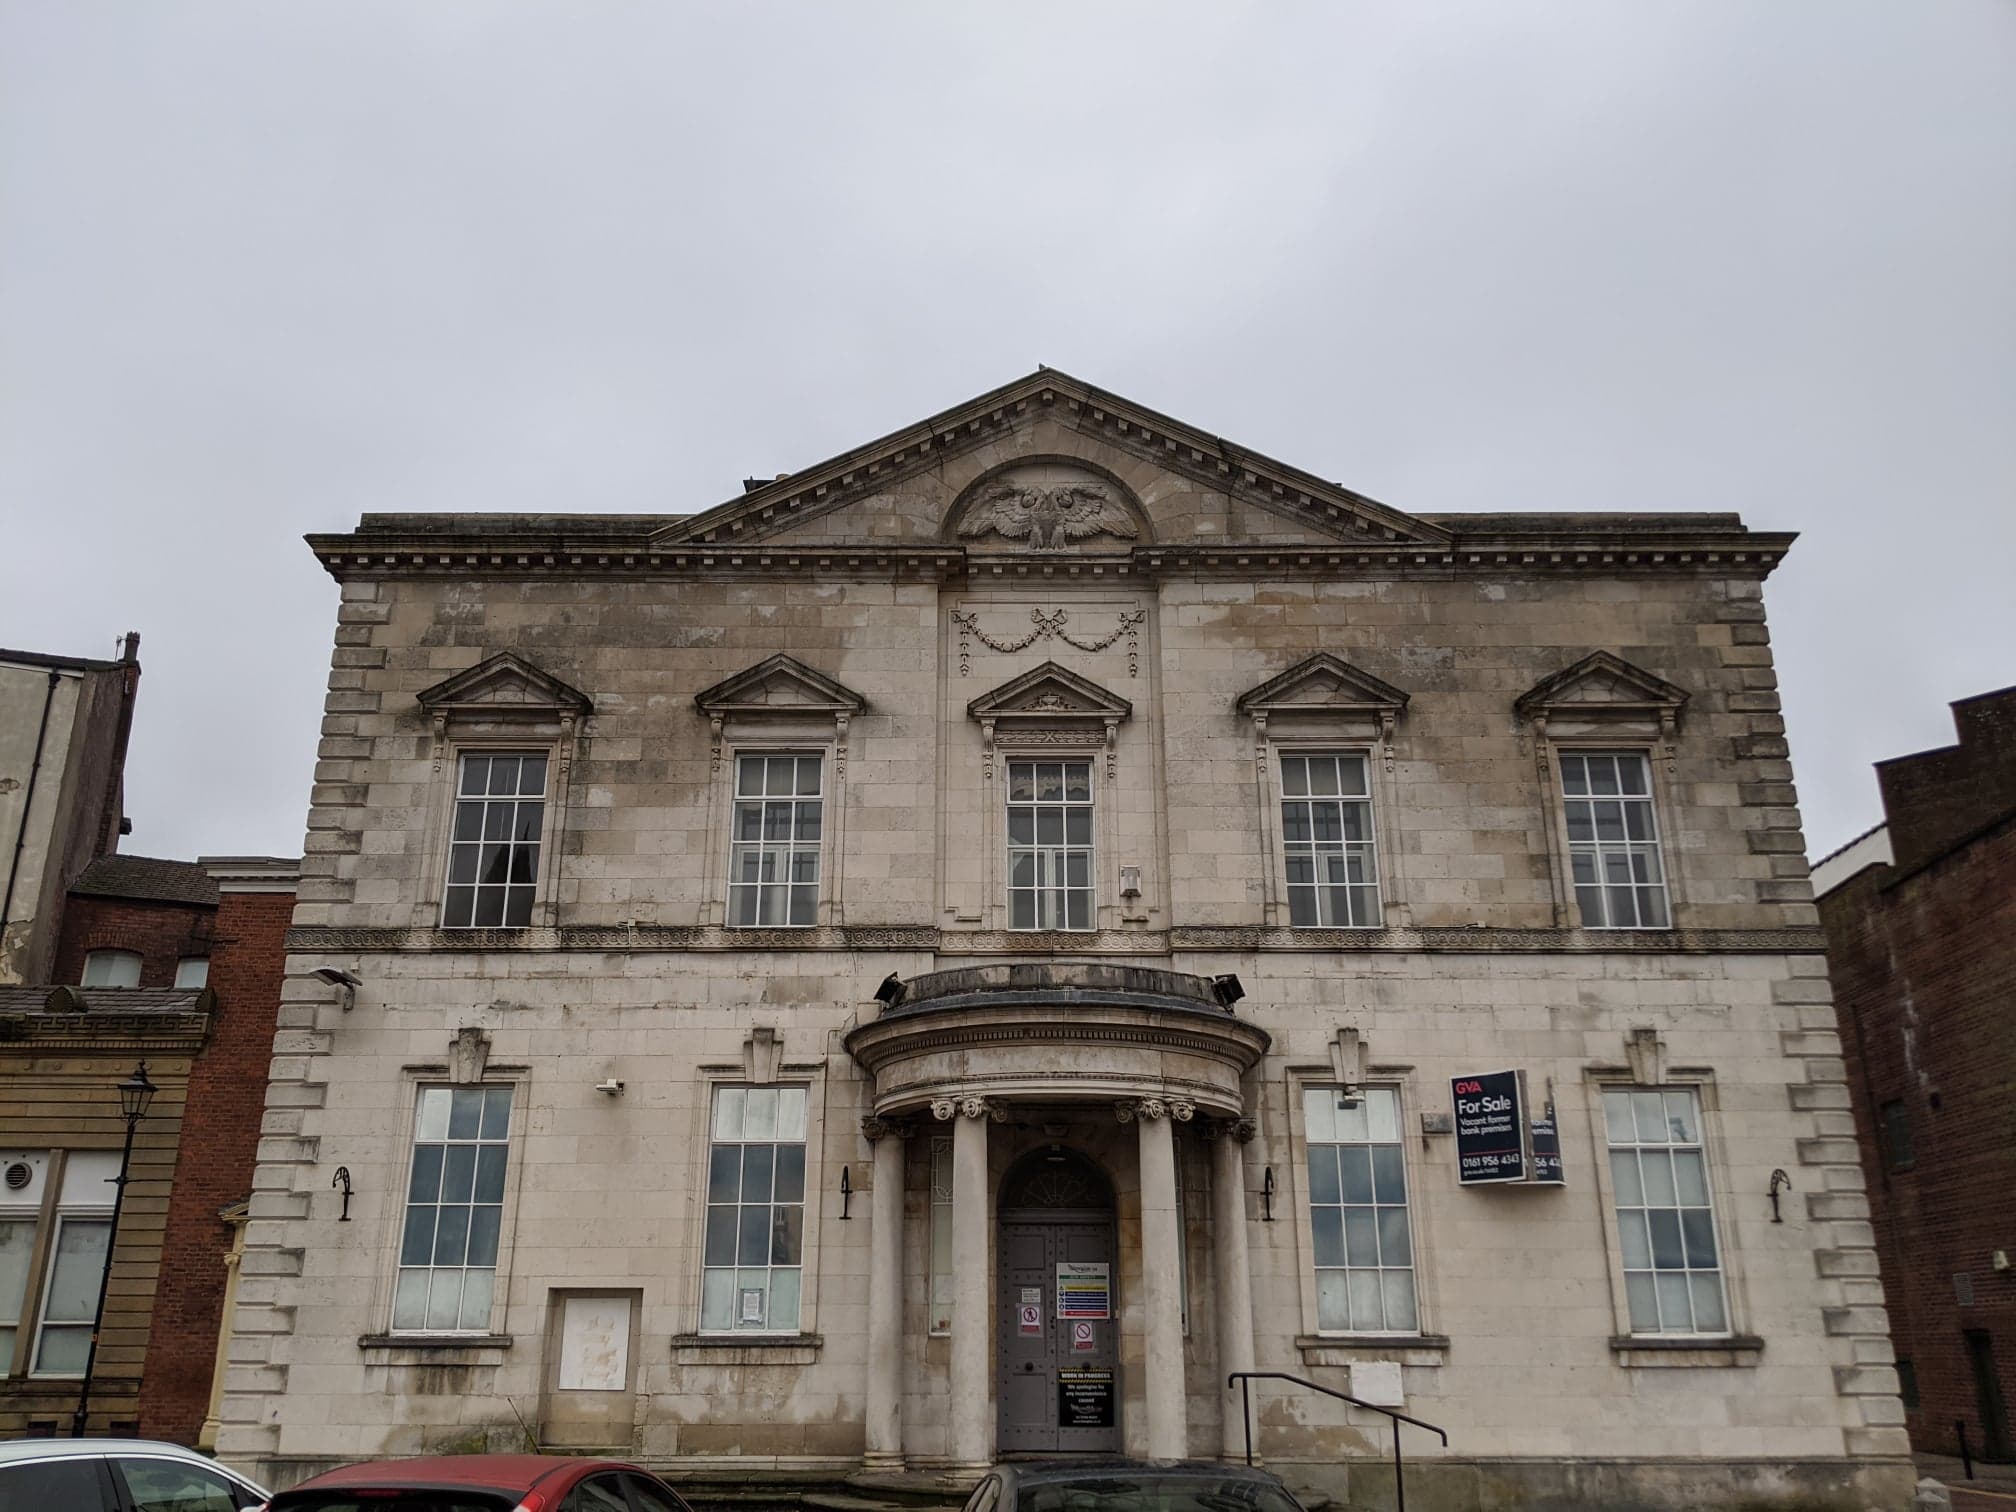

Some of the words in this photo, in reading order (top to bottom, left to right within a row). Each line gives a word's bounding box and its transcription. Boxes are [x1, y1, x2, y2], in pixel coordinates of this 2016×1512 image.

[1456, 1082, 1482, 1094] GVA
[1458, 1099, 1480, 1114] For
[1482, 1095, 1512, 1112] Sale
[1460, 1117, 1486, 1126] Vacant
[1487, 1115, 1511, 1124] former
[1460, 1125, 1480, 1135] bank
[1481, 1124, 1512, 1136] premises
[1462, 1157, 1481, 1168] 0161
[1482, 1155, 1500, 1166] 956
[1501, 1153, 1520, 1164] 4343
